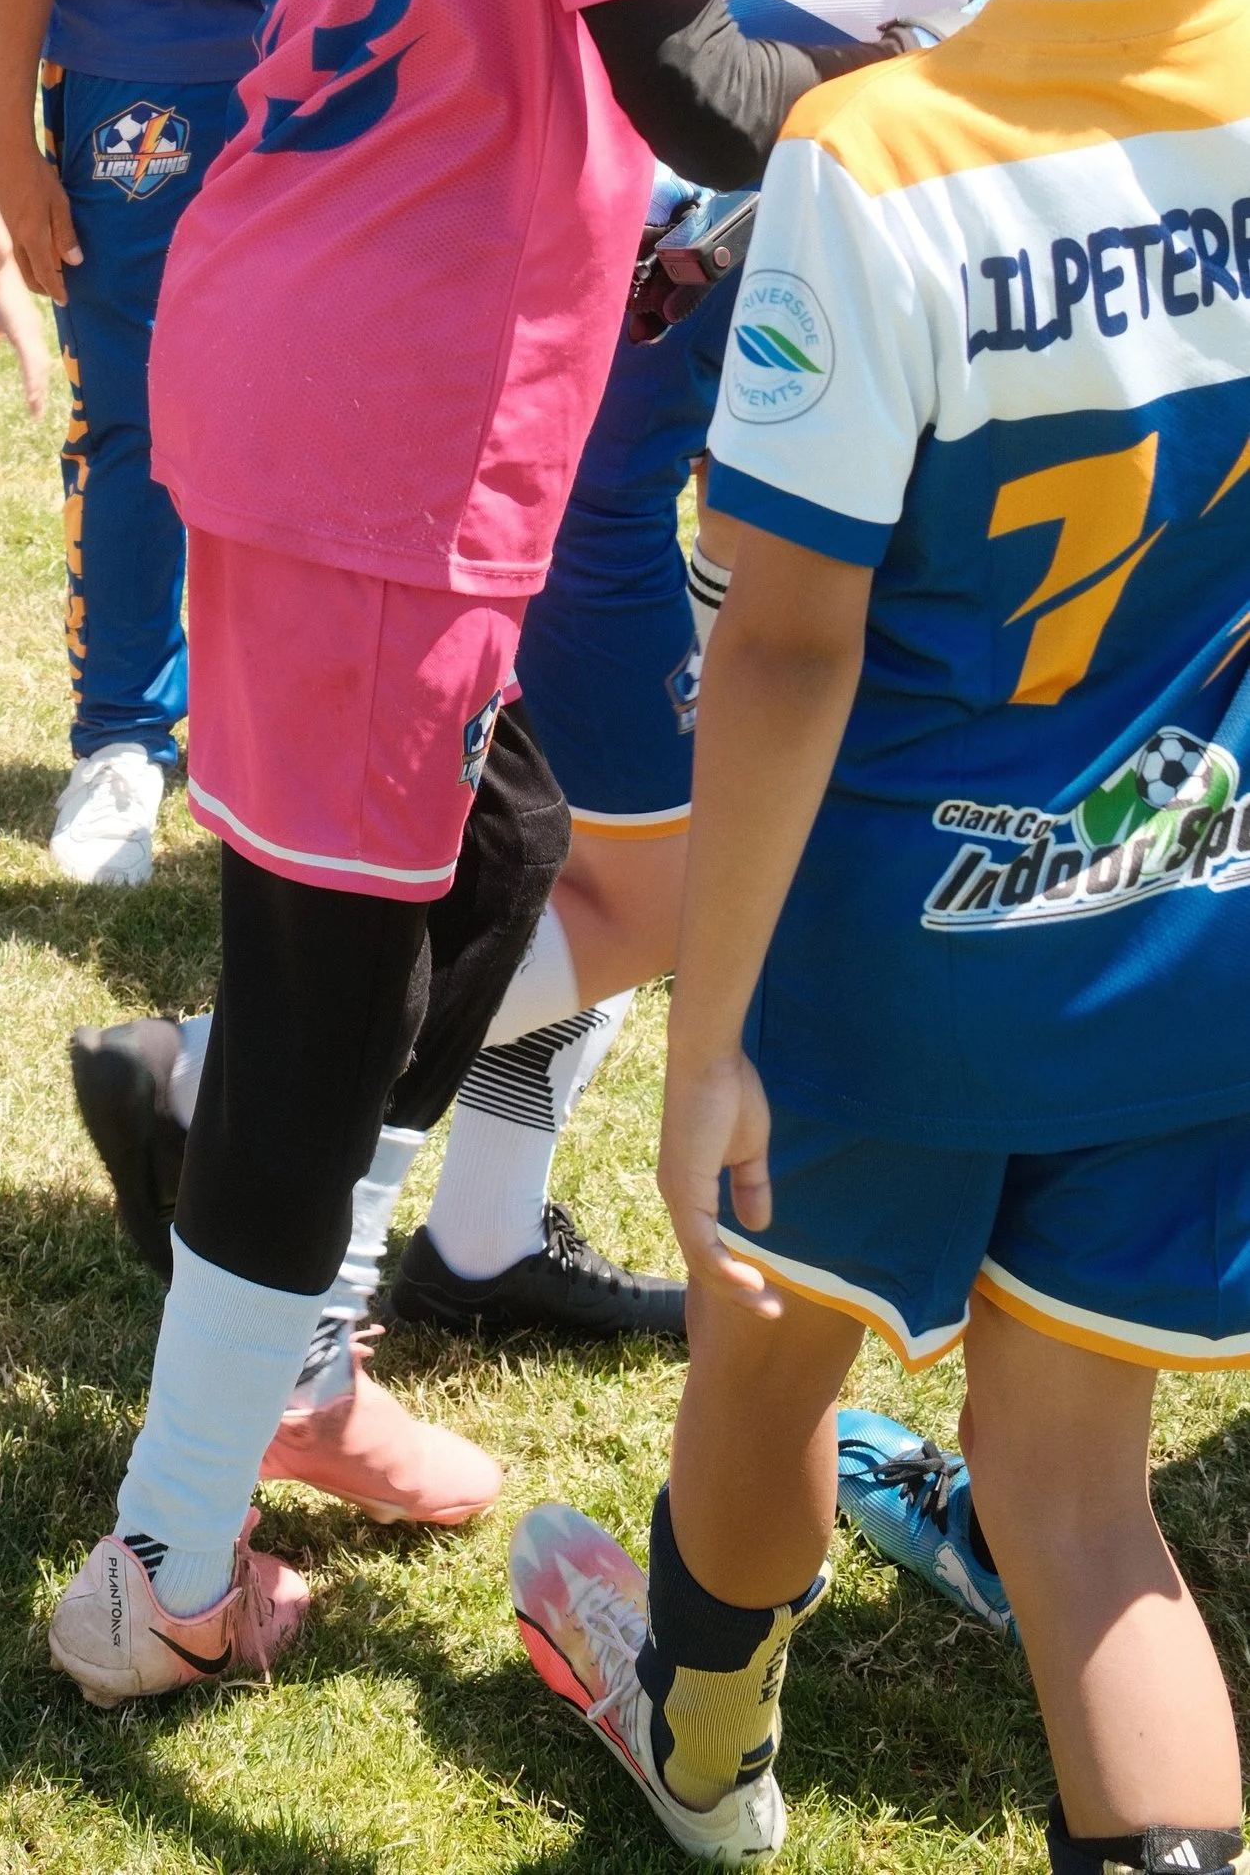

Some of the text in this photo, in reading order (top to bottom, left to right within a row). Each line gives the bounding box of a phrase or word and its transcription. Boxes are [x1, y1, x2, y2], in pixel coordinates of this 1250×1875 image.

[937, 804, 1060, 838] Clark Co
[932, 837, 1158, 912] Indoor
[108, 1556, 123, 1634] PHANTOM
